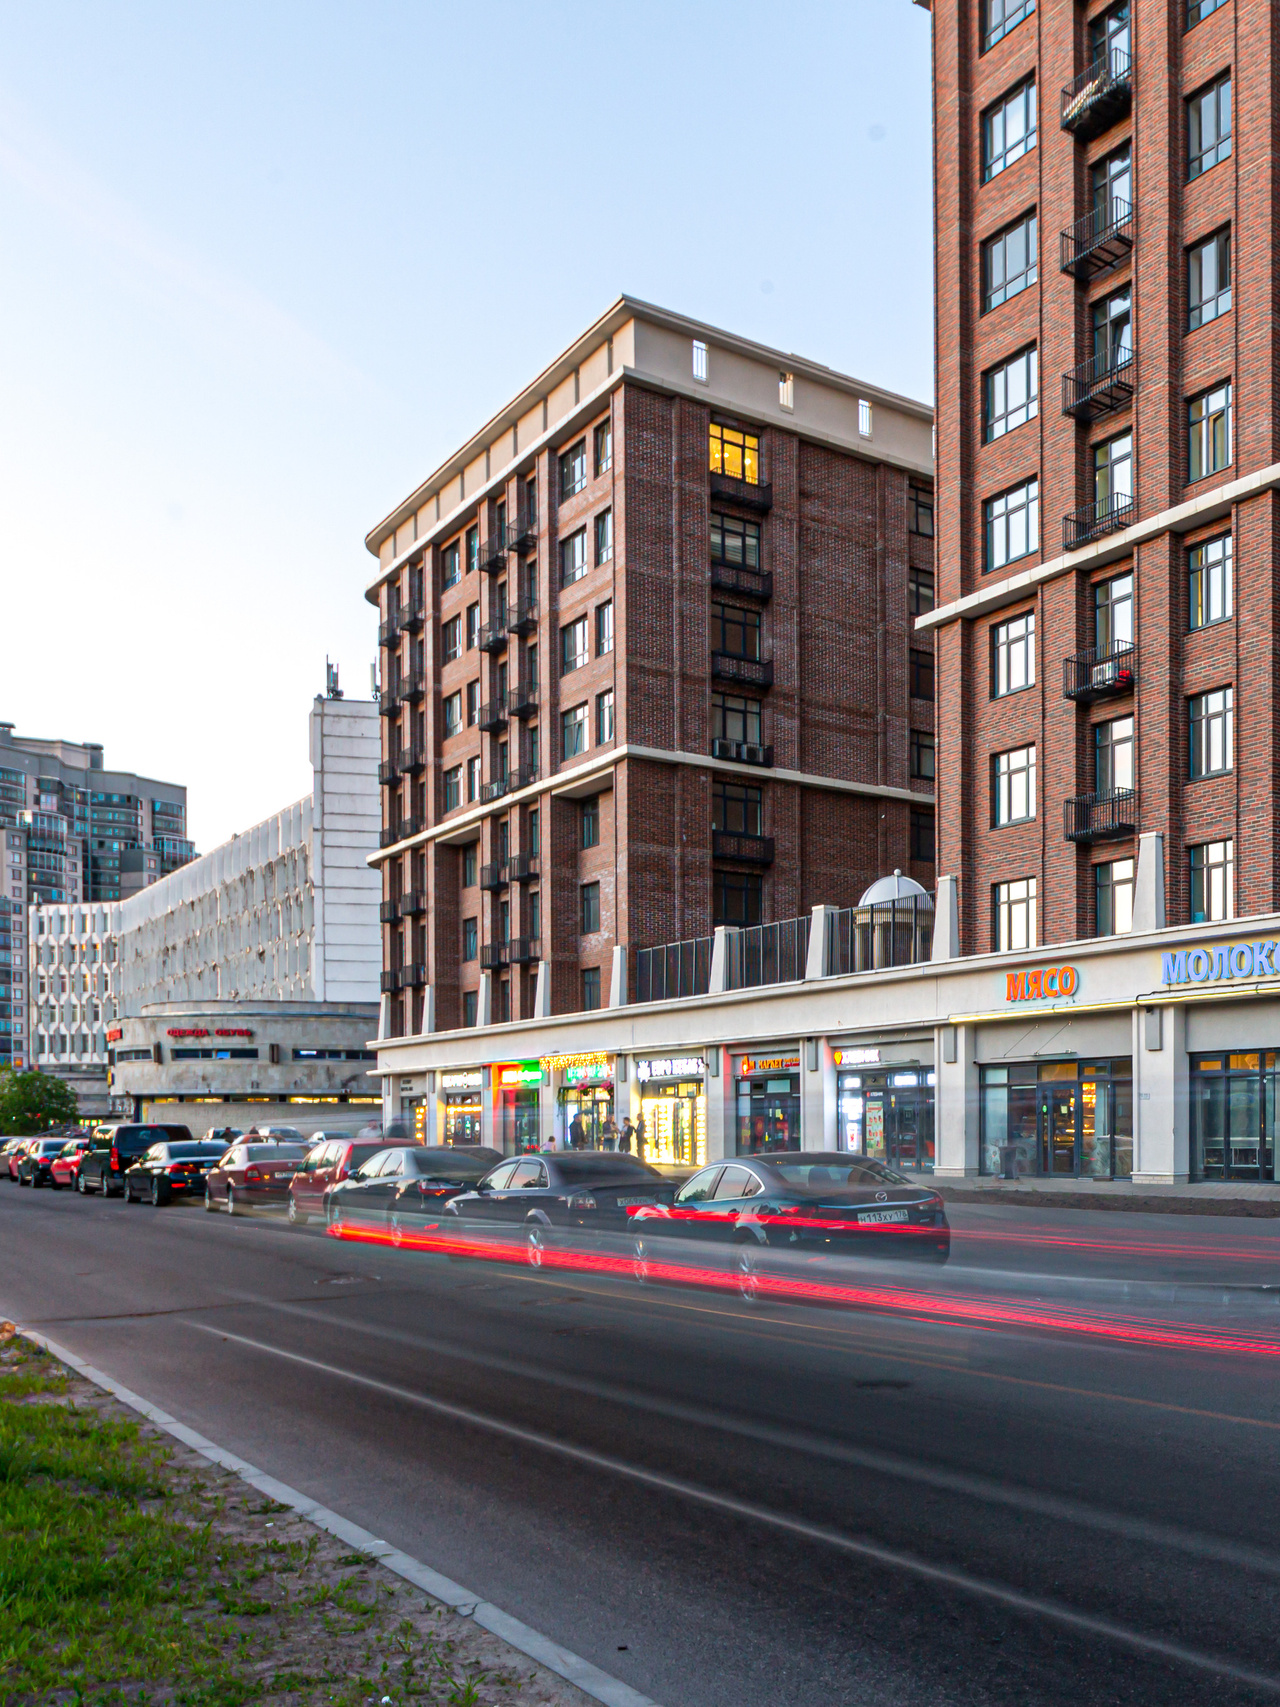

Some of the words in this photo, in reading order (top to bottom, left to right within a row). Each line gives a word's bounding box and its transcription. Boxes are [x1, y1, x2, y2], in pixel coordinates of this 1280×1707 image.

[1005, 965, 1077, 1001] МЯСО
[167, 1028, 209, 1037] ОДЕЖДА
[215, 1028, 252, 1037] ОБУВЬ
